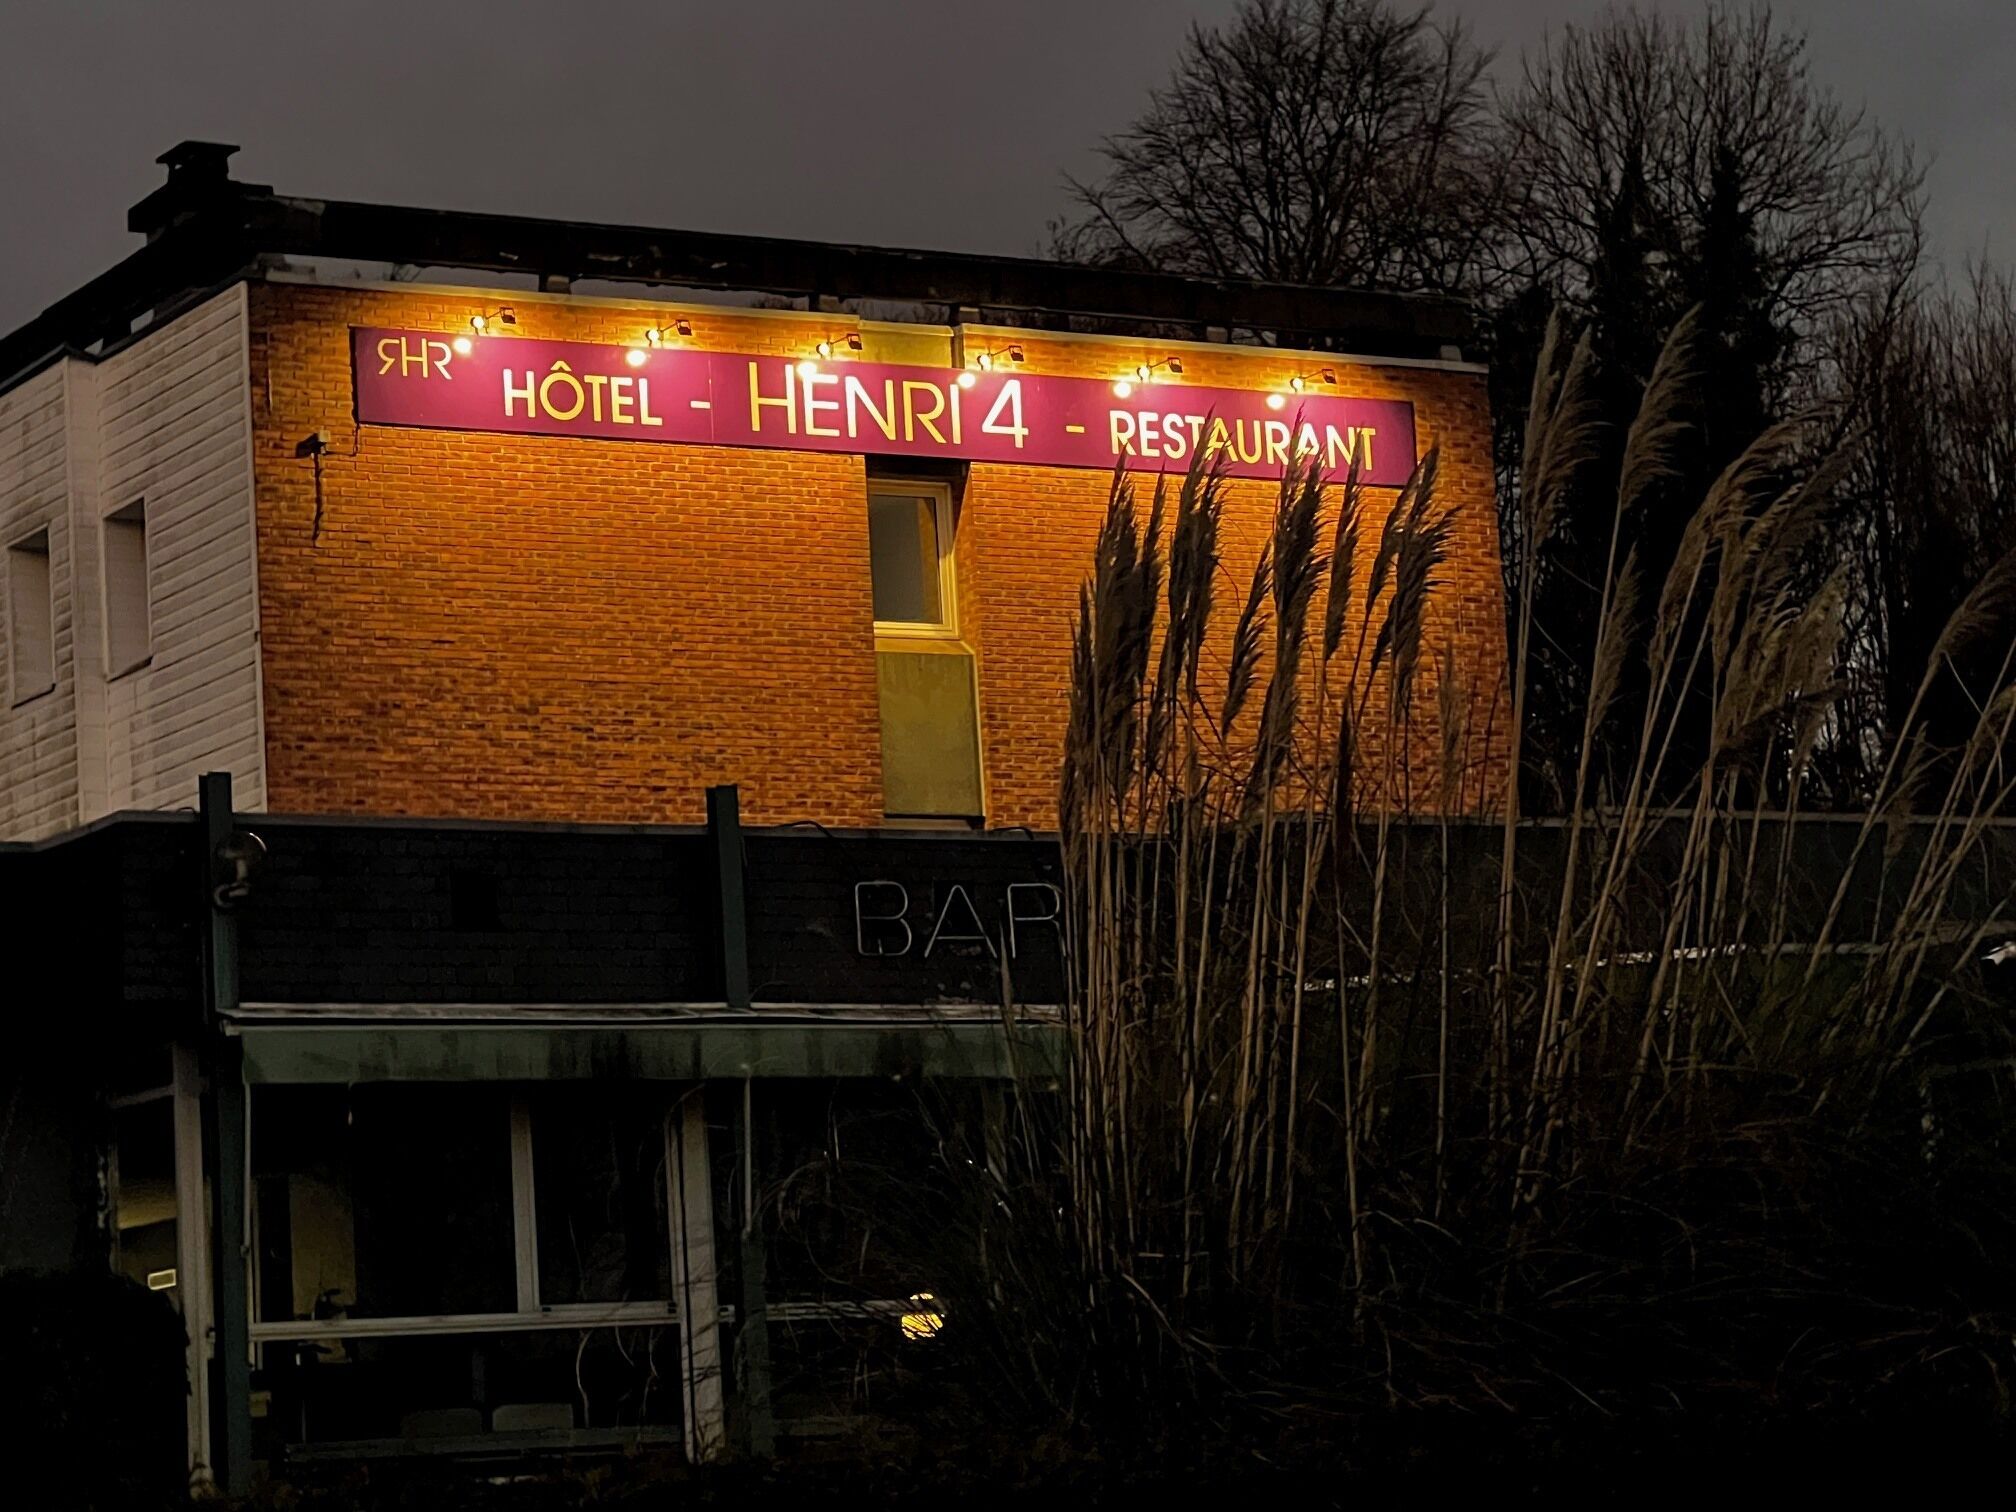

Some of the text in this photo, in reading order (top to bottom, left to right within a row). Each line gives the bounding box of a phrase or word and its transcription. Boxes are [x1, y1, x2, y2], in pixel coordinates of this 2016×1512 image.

[503, 361, 663, 426] HÔTEL
[748, 361, 962, 445] HENRI
[981, 379, 1029, 448] 4
[1109, 410, 1376, 470] RESTAURANT
[855, 881, 1068, 958] BAR
